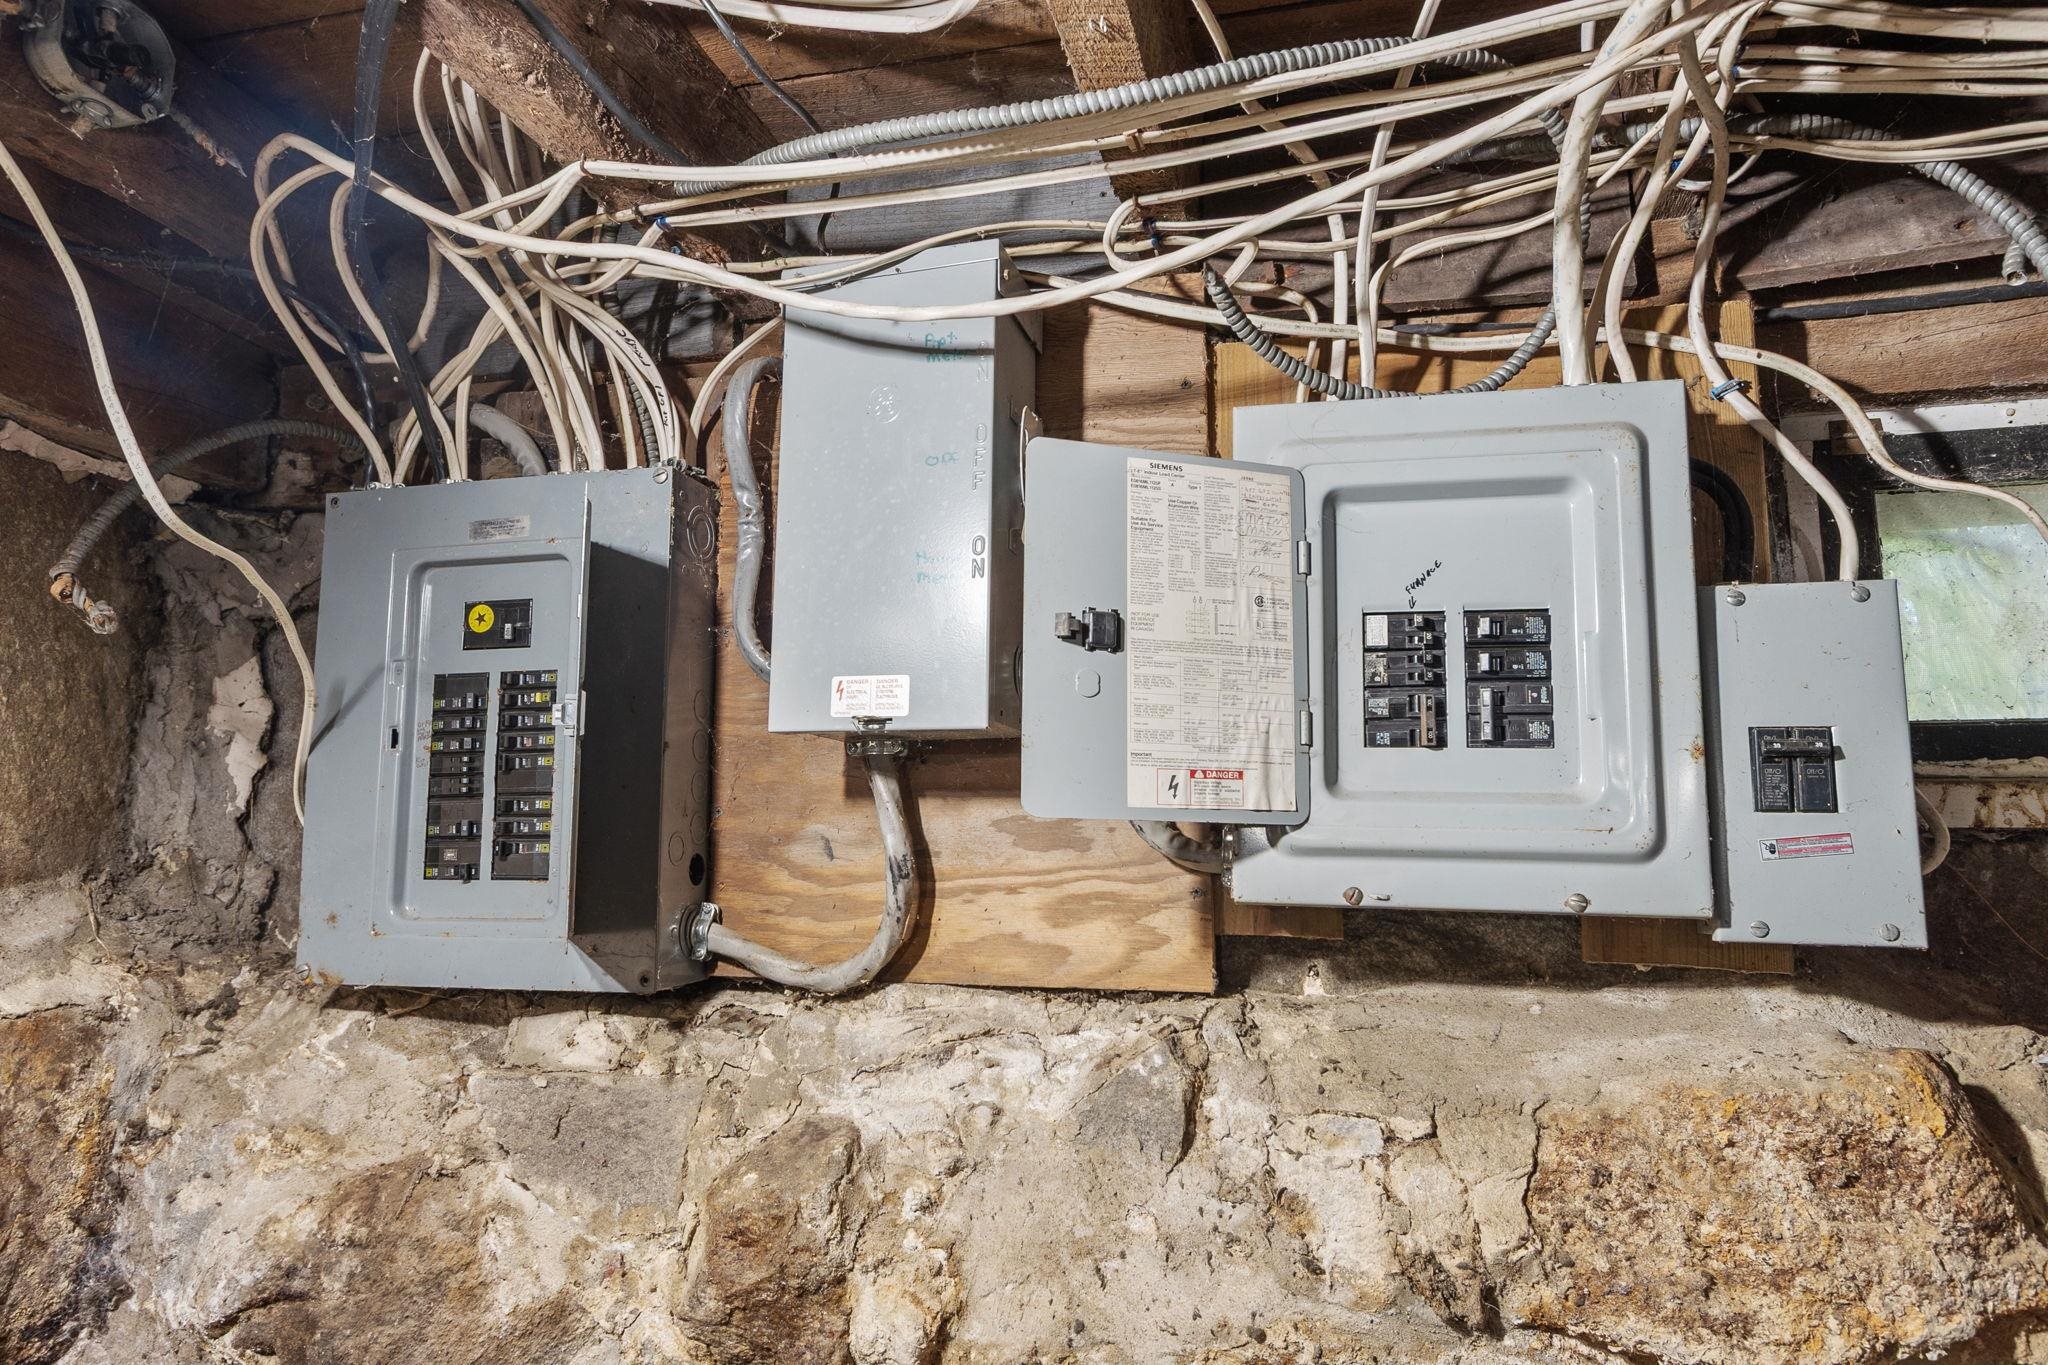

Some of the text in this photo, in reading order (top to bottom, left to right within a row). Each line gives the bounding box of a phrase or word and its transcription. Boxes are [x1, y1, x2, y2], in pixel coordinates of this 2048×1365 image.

[971, 423, 988, 492] OFF
[1149, 462, 1184, 472] SIEMENS
[971, 535, 986, 578] ON
[1206, 770, 1240, 779] DANGER
